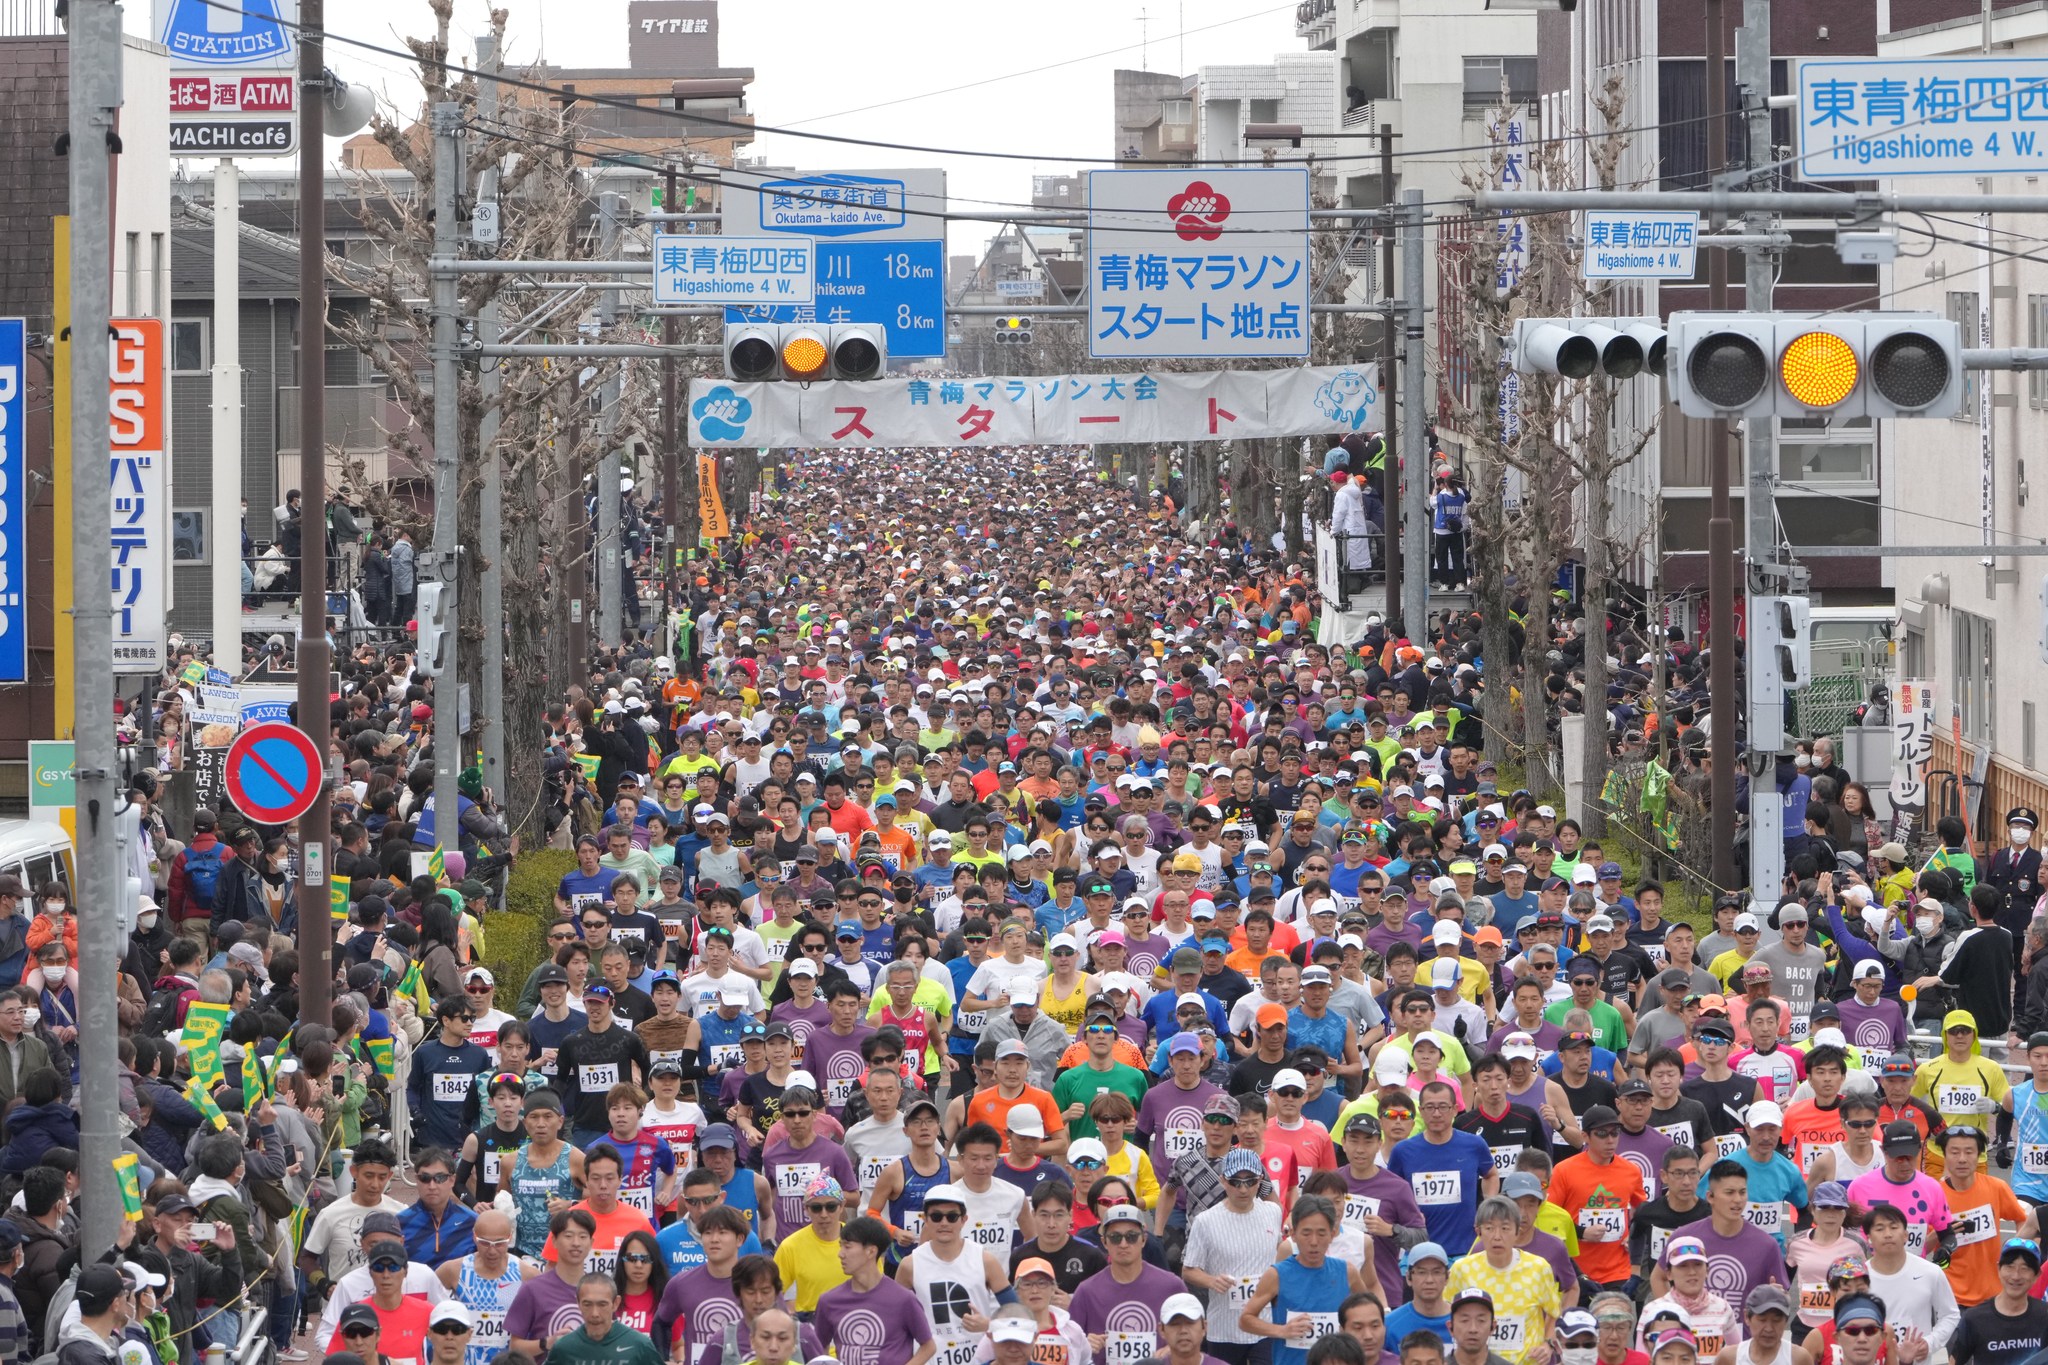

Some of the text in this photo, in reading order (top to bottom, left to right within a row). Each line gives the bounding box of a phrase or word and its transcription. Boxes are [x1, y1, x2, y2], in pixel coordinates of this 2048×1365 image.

[641, 19, 709, 33] ダイア建設
[173, 31, 275, 55] STATION
[214, 84, 237, 105] 酒
[243, 83, 289, 104] ATM
[1809, 76, 2048, 128] 東青梅四西
[240, 127, 286, 145] café
[1832, 131, 2043, 165] Higashiome 4 W.
[771, 188, 888, 210] 奥多摩街道
[863, 213, 886, 223] Ave.
[1590, 220, 1693, 250] 東青梅四西
[661, 246, 807, 274] 東青梅四西
[884, 254, 911, 279] 18
[913, 268, 933, 278] Km
[1597, 254, 1682, 270] Higashiome 4 W.
[1097, 254, 1301, 292] 青梅マラソン
[673, 278, 795, 295] Higashiome 4 W.
[897, 304, 912, 329] 8
[914, 319, 934, 329] Km
[1098, 302, 1302, 340] スタート地点
[109, 327, 146, 446] GS
[907, 375, 1158, 406] 青梅マラソン大会
[831, 397, 1237, 441] スタート
[114, 648, 156, 658] 梅電機商会
[202, 687, 240, 700] LAWSON
[1902, 685, 1913, 713] 無添加
[1921, 689, 1931, 708] 国産
[191, 711, 237, 724] LAWSON
[246, 706, 290, 719] LAWS
[1897, 722, 1919, 798] フルーツ
[42, 771, 58, 780] GS
[1786, 967, 1812, 980] BACK
[1791, 984, 1804, 996] TO
[586, 1070, 614, 1085] 1931
[440, 1081, 469, 1095] 1845
[836, 1085, 850, 1099] 18
[1947, 1091, 1977, 1106] 1989
[1173, 1136, 1203, 1150] 1936
[1801, 1130, 1845, 1142] TOKYO
[1494, 1154, 1517, 1168] 894
[518, 1178, 560, 1187] IRONMAN
[1415, 1179, 1455, 1196] F 1977
[518, 1187, 535, 1195] 70.3
[1346, 1203, 1371, 1219] 970
[1747, 1210, 1778, 1225] 2033
[971, 1227, 1005, 1244] 1802
[1907, 1231, 1922, 1246] 96
[589, 1258, 615, 1274] 184
[1238, 1283, 1255, 1298] 16
[1803, 1291, 1831, 1307] F 202
[622, 1311, 646, 1329] bil
[1492, 1324, 1518, 1341] 487
[1108, 1340, 1150, 1359] F 1958
[1988, 1337, 2041, 1351] GARMIN
